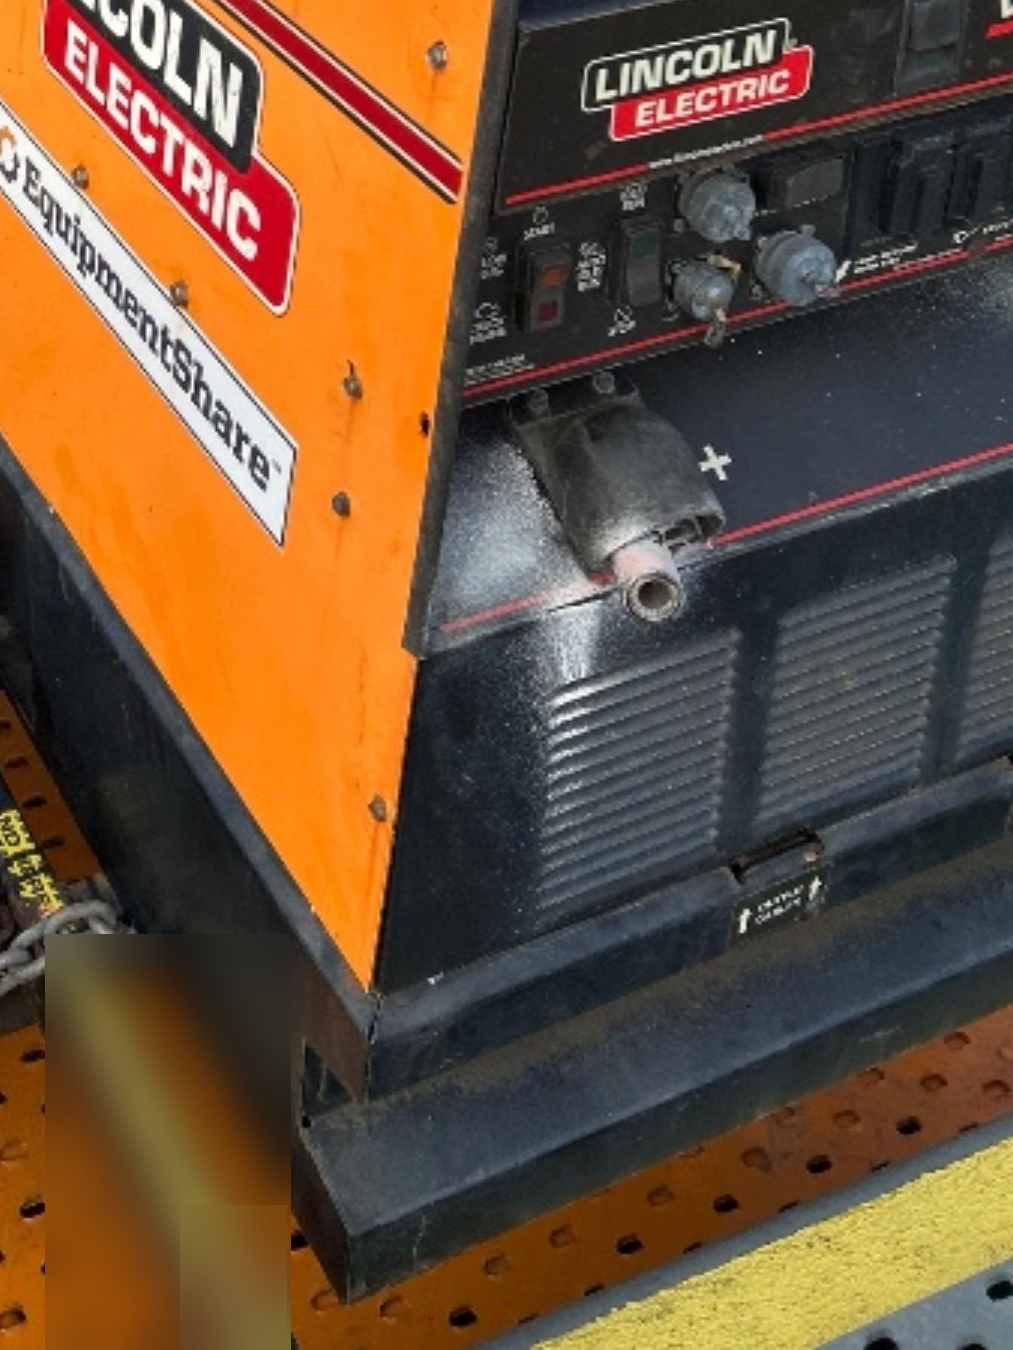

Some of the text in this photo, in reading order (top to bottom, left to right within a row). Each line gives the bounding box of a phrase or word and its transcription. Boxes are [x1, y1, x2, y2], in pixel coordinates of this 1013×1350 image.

[63, 17, 262, 262] ELECTRIC
[595, 29, 778, 102] LINCOLN
[634, 69, 790, 128] ELECTRIC
[22, 154, 274, 493] EquipmentShare
